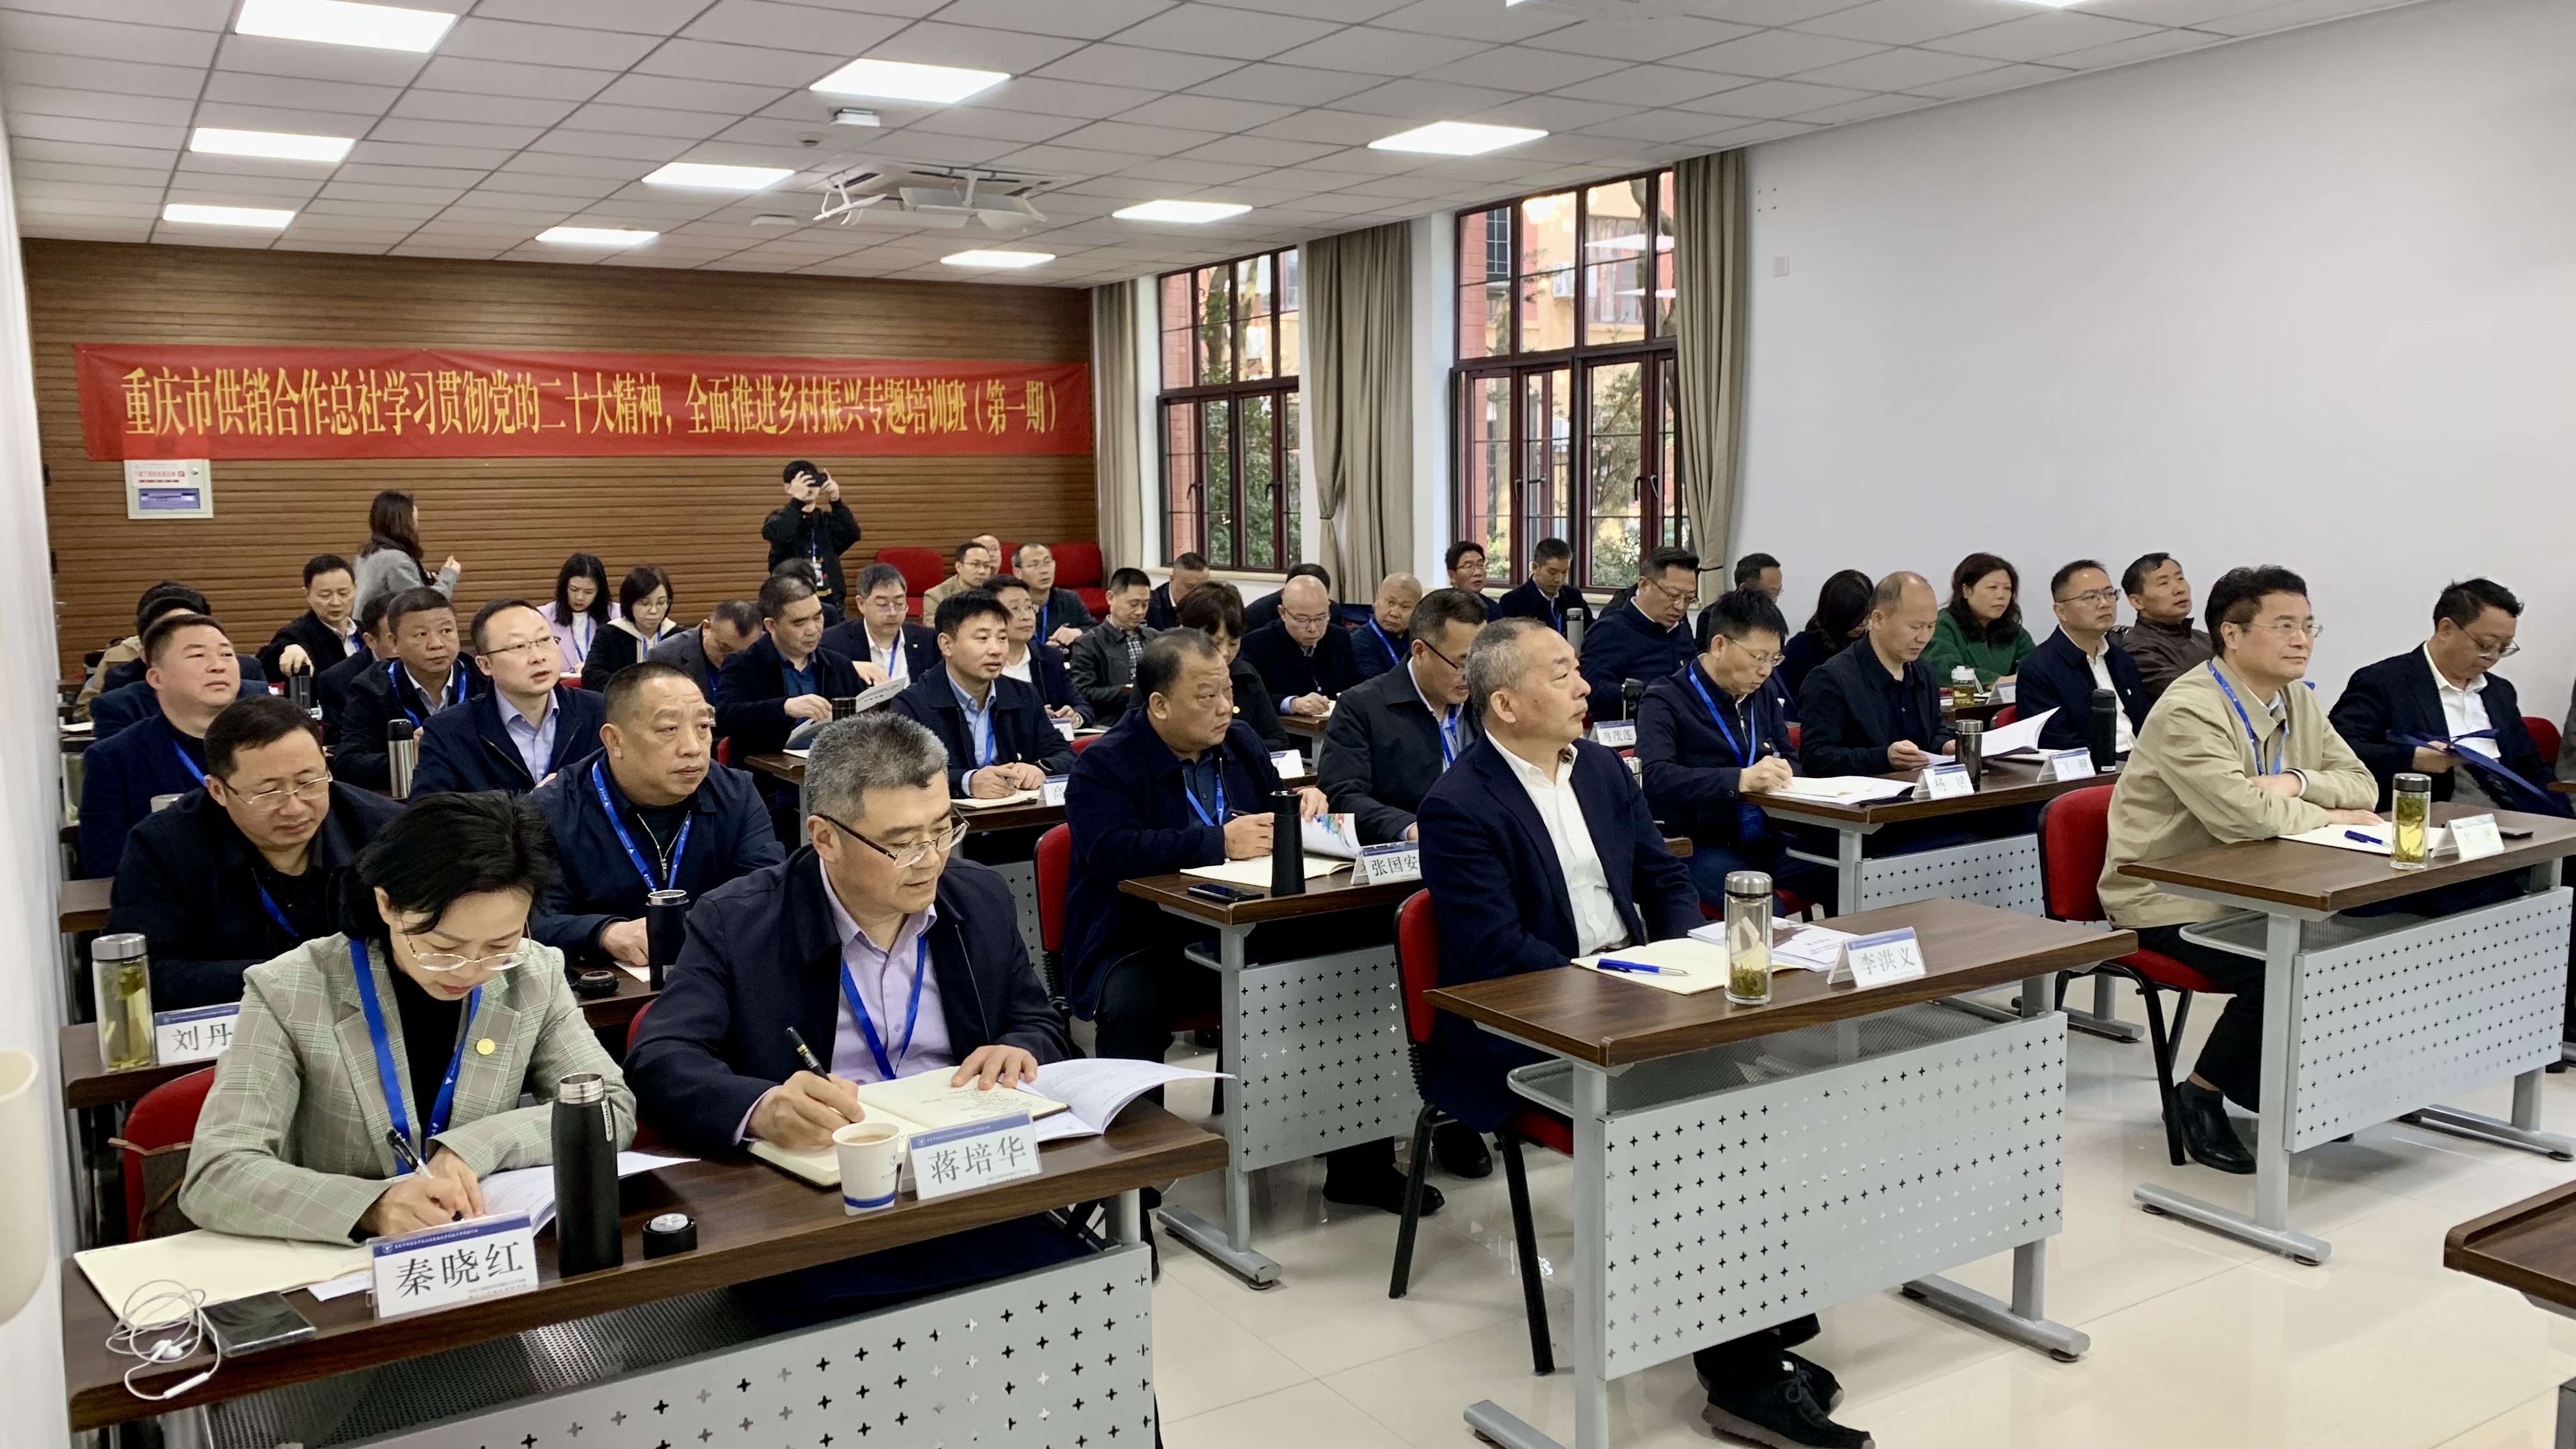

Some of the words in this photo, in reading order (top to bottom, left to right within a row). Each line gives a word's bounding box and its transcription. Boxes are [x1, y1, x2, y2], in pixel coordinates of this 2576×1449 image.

[1370, 855, 1419, 877] 张国安
[1859, 947, 1916, 976] 李洪义
[928, 1135, 1027, 1184] 蒋培华
[395, 1241, 524, 1299] 秦晓红
